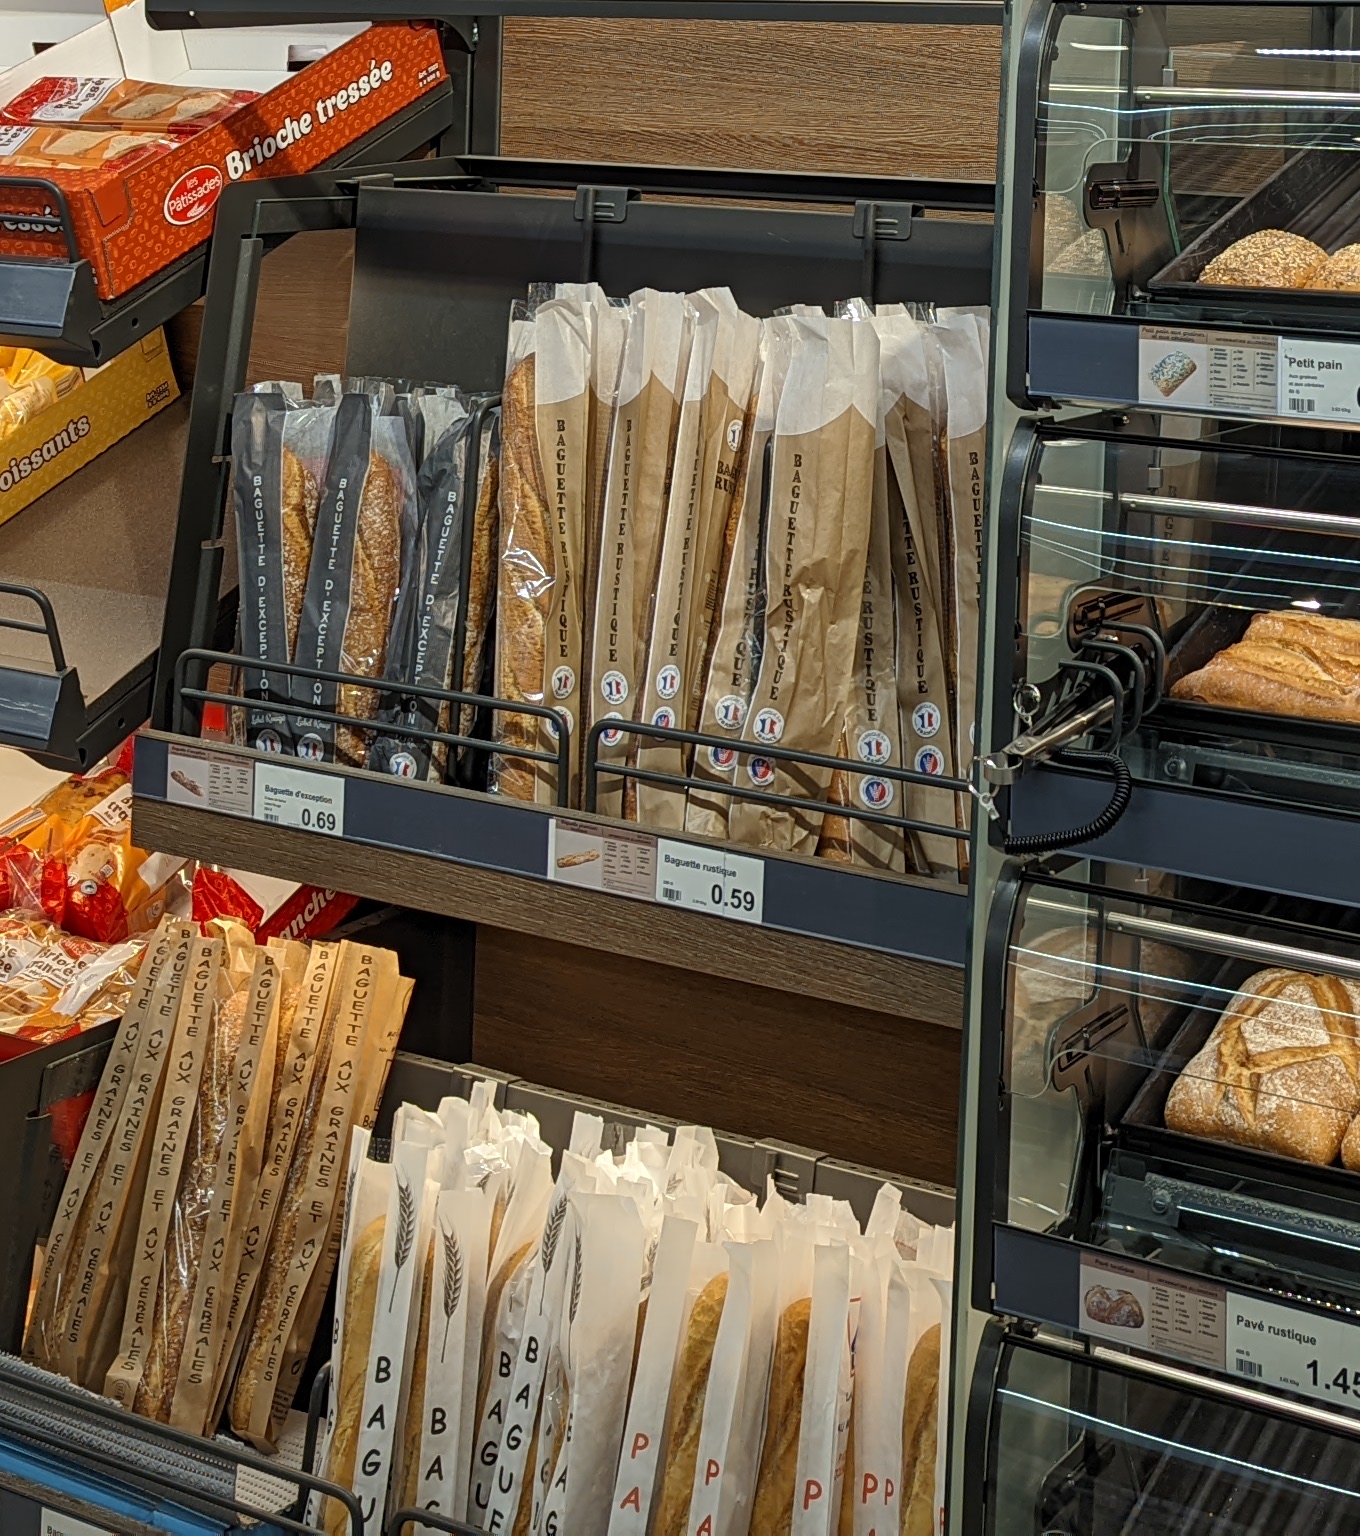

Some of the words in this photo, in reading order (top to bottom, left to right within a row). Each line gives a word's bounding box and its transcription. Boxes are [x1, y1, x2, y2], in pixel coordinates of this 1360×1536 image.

[225, 112, 313, 181] Brioche
[315, 58, 393, 124] tressée
[168, 174, 221, 216] Pâtissades
[186, 176, 199, 189] les
[1288, 357, 1315, 369] Petit
[1317, 359, 1343, 371] pain
[556, 419, 567, 535] BAGUETTE
[618, 419, 632, 537] BAGUETTE
[784, 453, 803, 578] BAGUETTE
[252, 475, 266, 567] BAGUETTE
[327, 478, 348, 570] BAGUETTE
[430, 491, 457, 585] BAGUETTE
[559, 540, 571, 658] RUSTIQUE
[608, 542, 624, 663] RUSTIQUE
[668, 536, 690, 657] RUSTIQUE
[908, 571, 929, 694] RUSTIQUE
[313, 579, 334, 706] D'EXCEPTON
[407, 594, 435, 725] D'EXCEPTON
[769, 583, 794, 701] RUSTIQUE
[862, 600, 878, 722] RUSTIQUE
[718, 715, 741, 729] FRANCE
[756, 730, 779, 743] FRANCE
[264, 783, 294, 798] Baguette
[295, 787, 333, 805] d'exception
[301, 808, 337, 831] 0.69
[664, 853, 701, 870] Baguette
[702, 861, 738, 878] rustique
[711, 883, 755, 912] 0.59
[159, 929, 191, 1017] BAGUETTE
[186, 947, 213, 1038] BAGUETTE
[248, 955, 275, 1046] BAGUETTE
[299, 950, 329, 1039] BAGUETTE
[345, 955, 373, 1047] BAGUETTE
[120, 1021, 140, 1053] AUX
[145, 1028, 164, 1062] AUX
[175, 1050, 194, 1084] AUX
[237, 1058, 254, 1092] AUX
[291, 1052, 307, 1085] AUX
[91, 1064, 126, 1141] GRAINES
[119, 1073, 152, 1152] GRAINES
[334, 1060, 353, 1094] AUX
[80, 1152, 93, 1175] ET
[111, 1164, 125, 1186] ET
[157, 1096, 186, 1177] GRAINES
[225, 1104, 246, 1186] GRAINES
[269, 1097, 298, 1177] GRAINES
[315, 1106, 344, 1188] GRAINES
[62, 1187, 80, 1221] AUX
[95, 1201, 113, 1234] AUX
[151, 1189, 166, 1213] ET
[219, 1199, 232, 1222] ET
[258, 1189, 271, 1210] ET
[310, 1200, 324, 1223] ET
[143, 1227, 159, 1262] AUX
[209, 1237, 224, 1272] AUX
[242, 1225, 260, 1260] AUX
[296, 1238, 316, 1271] AUX
[68, 1247, 101, 1344] CEREALES
[121, 1275, 151, 1371] CEREALES
[187, 1285, 216, 1384] CEREALES
[264, 1284, 299, 1382] CEREALES
[1236, 1313, 1265, 1333] Pavé
[1268, 1322, 1317, 1346] rustique
